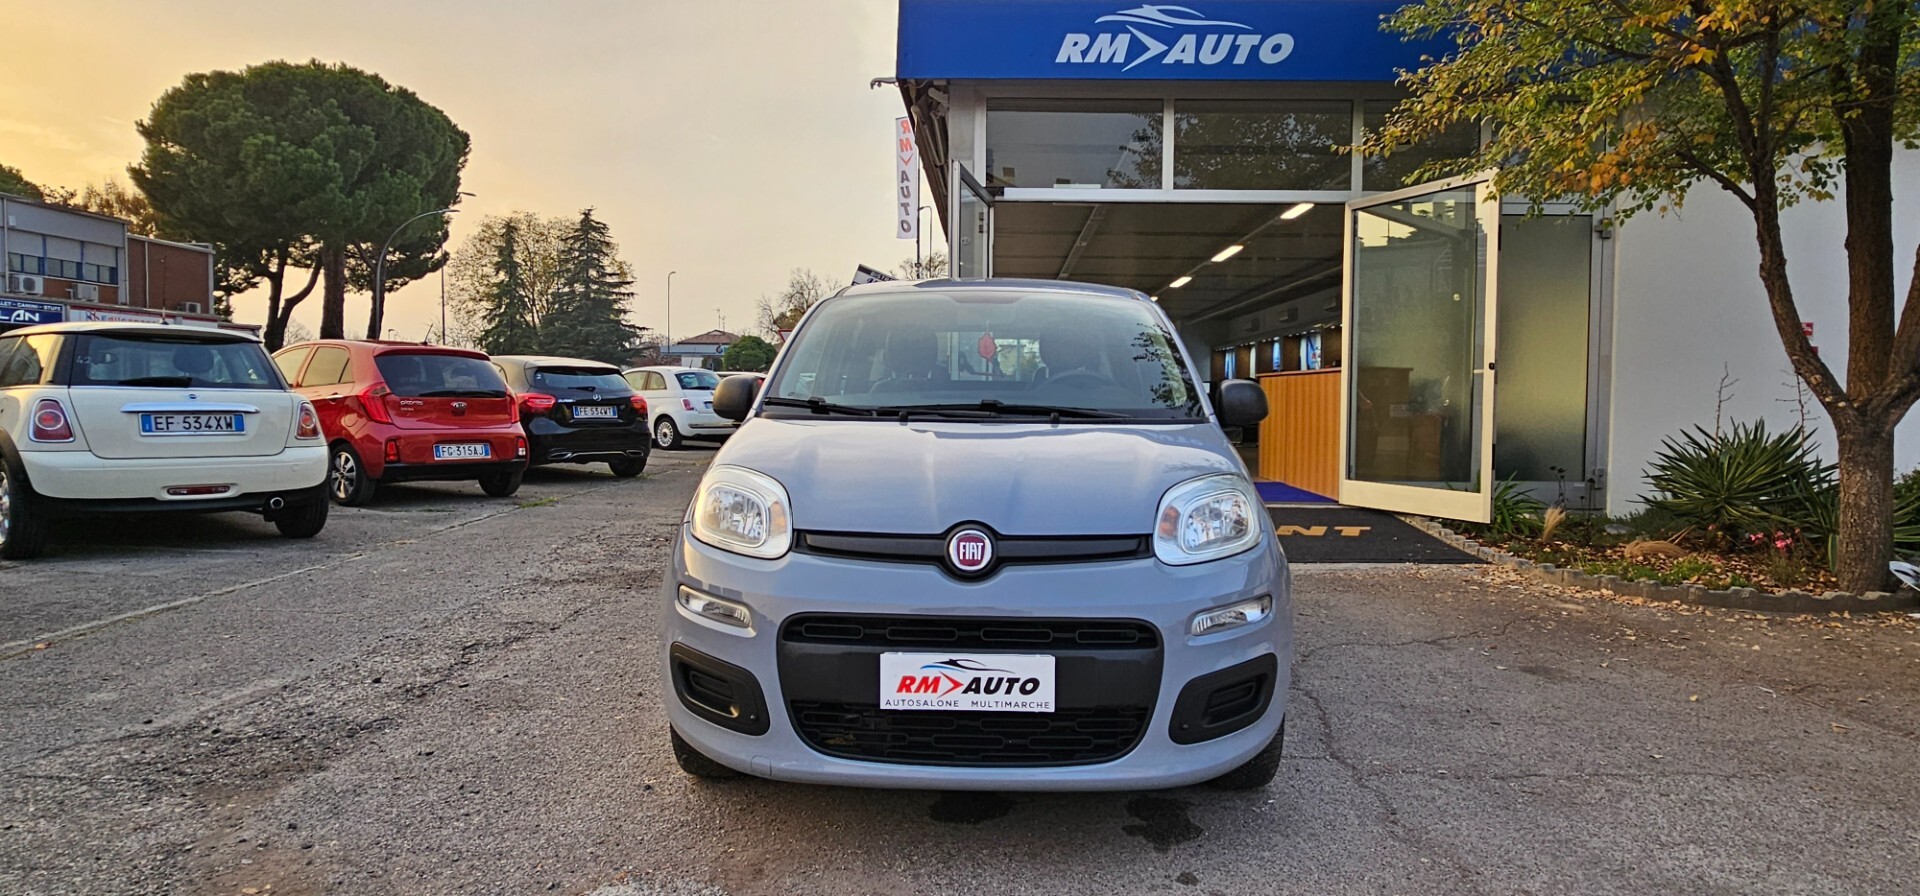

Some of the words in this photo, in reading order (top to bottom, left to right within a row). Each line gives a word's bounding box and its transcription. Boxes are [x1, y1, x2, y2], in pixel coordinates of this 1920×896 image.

[1055, 33, 1131, 64] RM
[1161, 32, 1295, 65] AUTO
[580, 407, 588, 416] FE
[154, 416, 174, 431] EF
[182, 415, 233, 430] 534XW
[441, 447, 452, 456] FG
[456, 446, 484, 456] 315AJ
[959, 542, 984, 560] FIAT
[896, 675, 942, 694] RM
[961, 676, 1041, 695] AUTO
[885, 699, 959, 708] AUTOSALONE
[971, 700, 1050, 709] MULTIMARCHE
